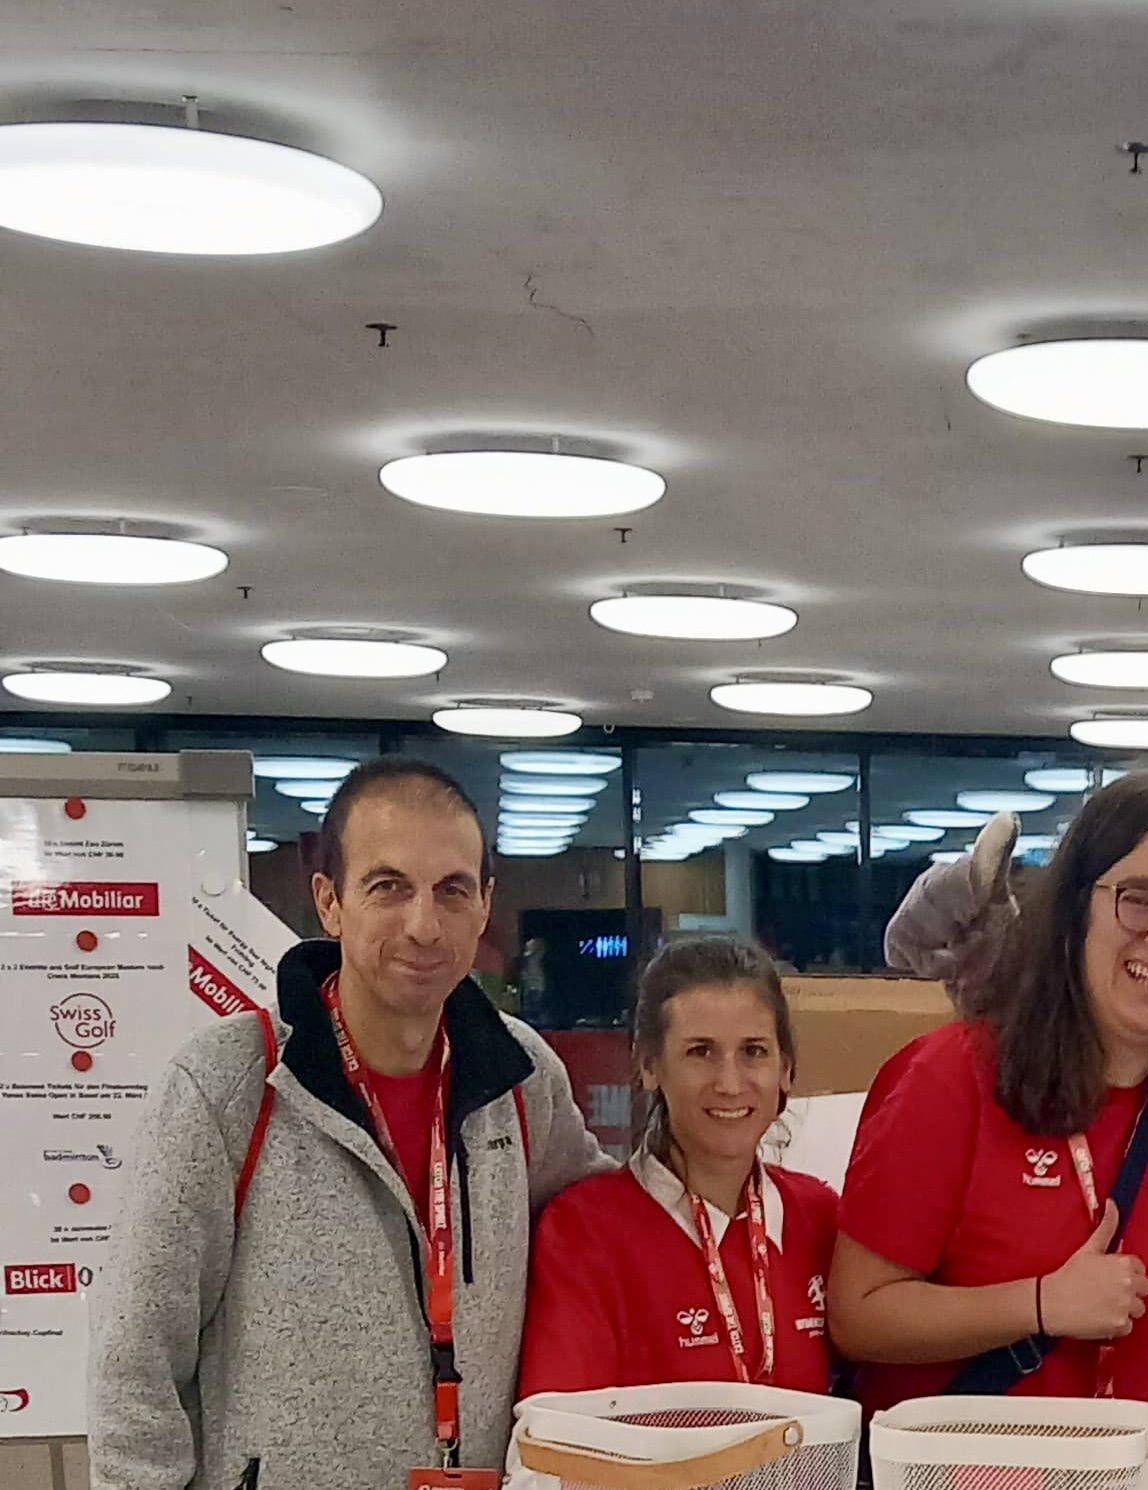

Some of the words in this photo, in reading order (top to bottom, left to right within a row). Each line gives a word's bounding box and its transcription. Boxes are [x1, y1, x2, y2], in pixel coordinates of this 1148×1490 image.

[59, 890, 144, 909] Mobiliar
[50, 1005, 102, 1021] Swiss
[75, 1020, 117, 1038] Golf
[10, 1268, 65, 1290] Blick
